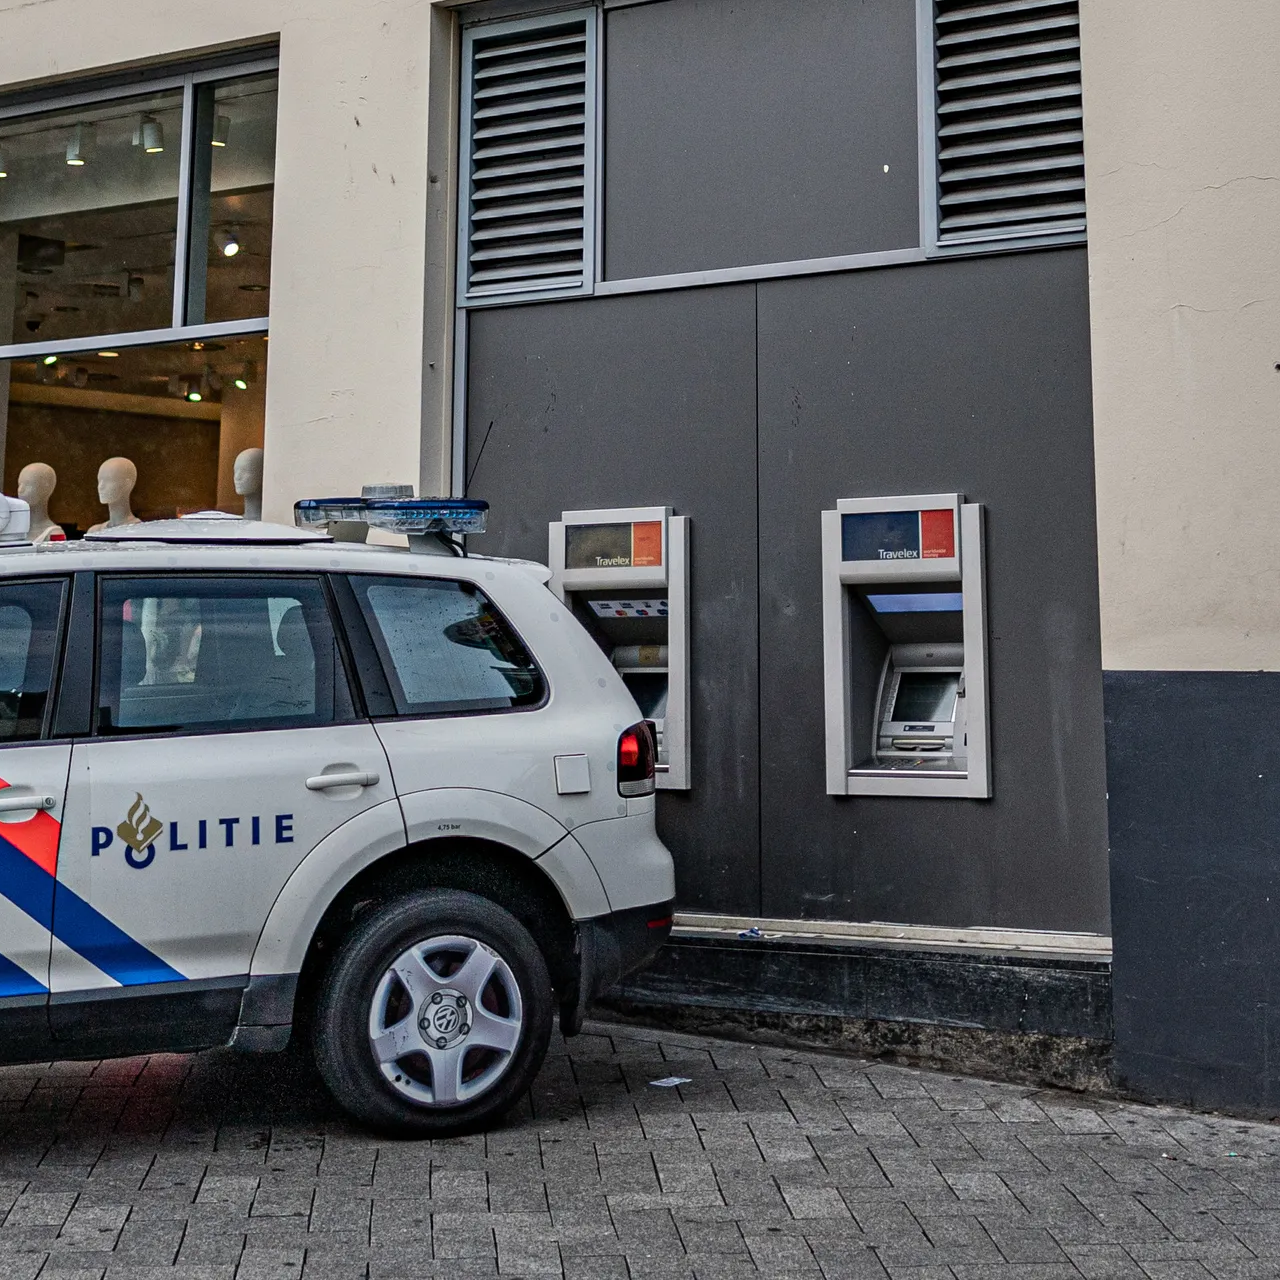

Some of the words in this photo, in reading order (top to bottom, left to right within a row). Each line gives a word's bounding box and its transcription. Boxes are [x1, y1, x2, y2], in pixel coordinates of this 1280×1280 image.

[878, 549, 918, 559] Travelex
[595, 556, 630, 566] Travelex
[91, 813, 294, 869] POLITIE
